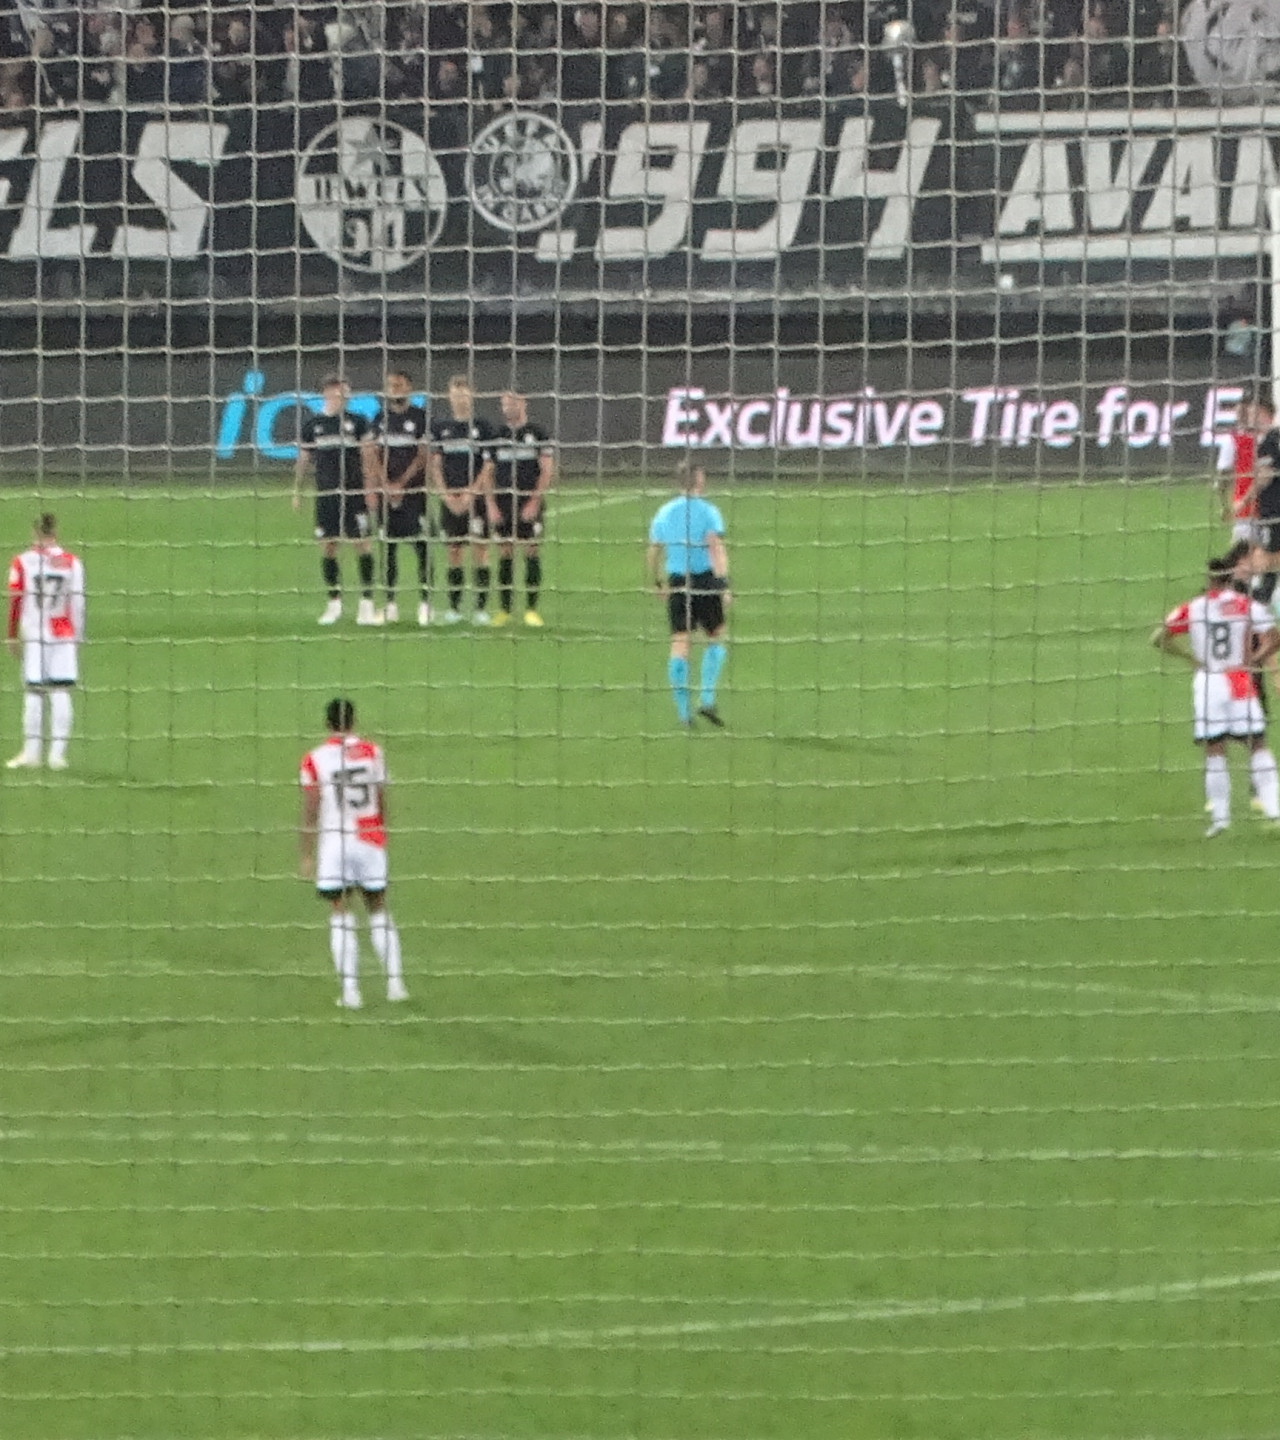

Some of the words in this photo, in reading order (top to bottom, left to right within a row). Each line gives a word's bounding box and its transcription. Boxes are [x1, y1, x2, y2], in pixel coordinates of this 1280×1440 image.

[662, 387, 945, 448] Exclusive
[963, 388, 1080, 448] Tire
[1097, 386, 1189, 448] for
[33, 573, 64, 610] 17
[332, 766, 369, 809] 15
